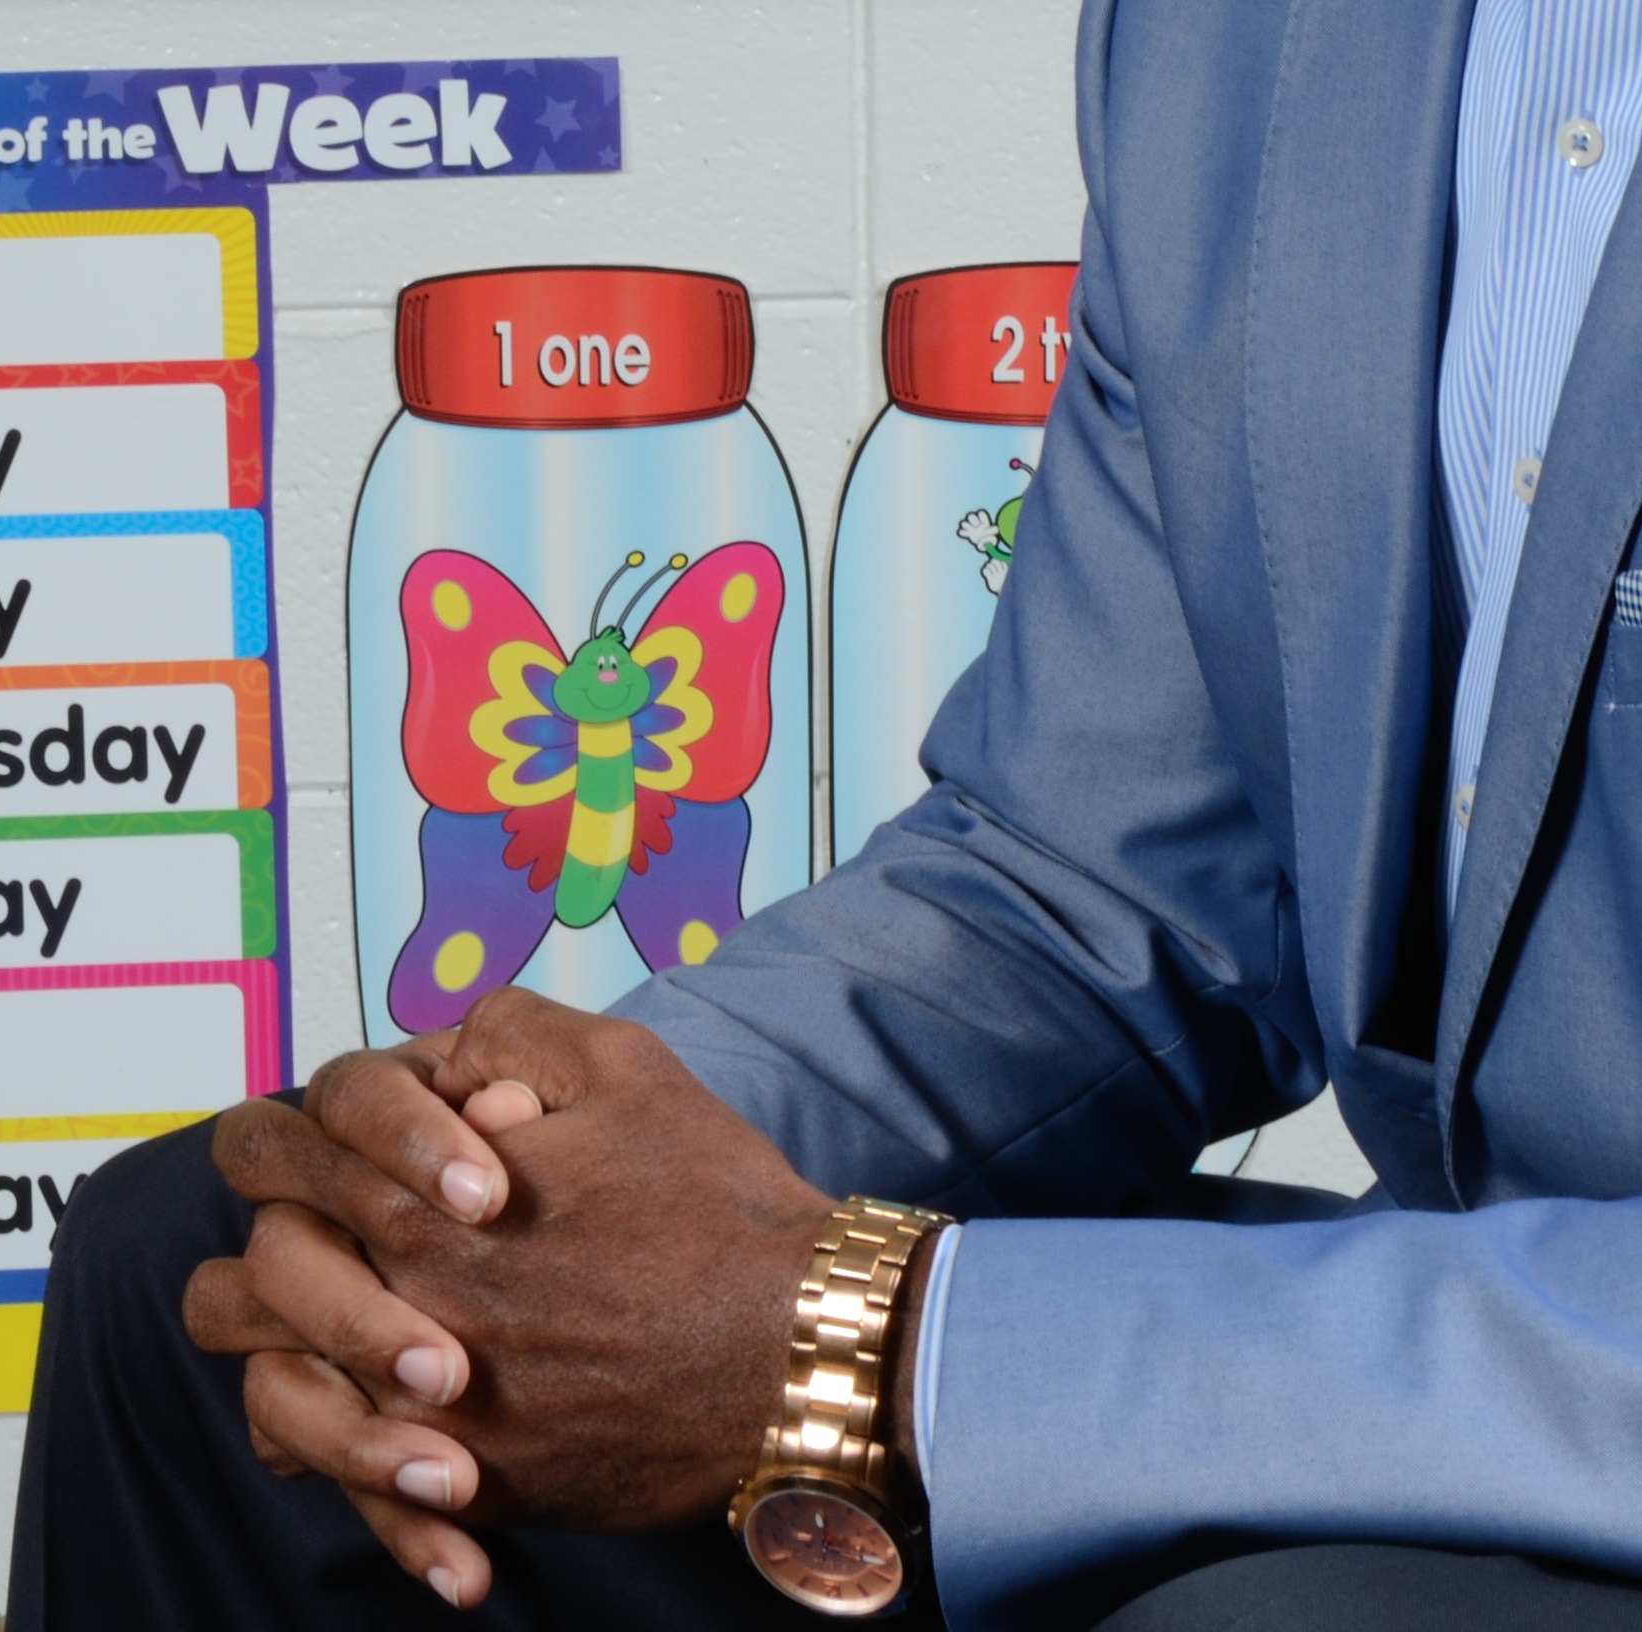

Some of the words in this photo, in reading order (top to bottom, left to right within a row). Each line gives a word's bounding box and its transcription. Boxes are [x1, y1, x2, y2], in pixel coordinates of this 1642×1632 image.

[63, 112, 156, 160] the
[158, 80, 514, 174] Week
[493, 320, 513, 388] 1
[538, 328, 651, 386] one
[991, 316, 1024, 383] 2
